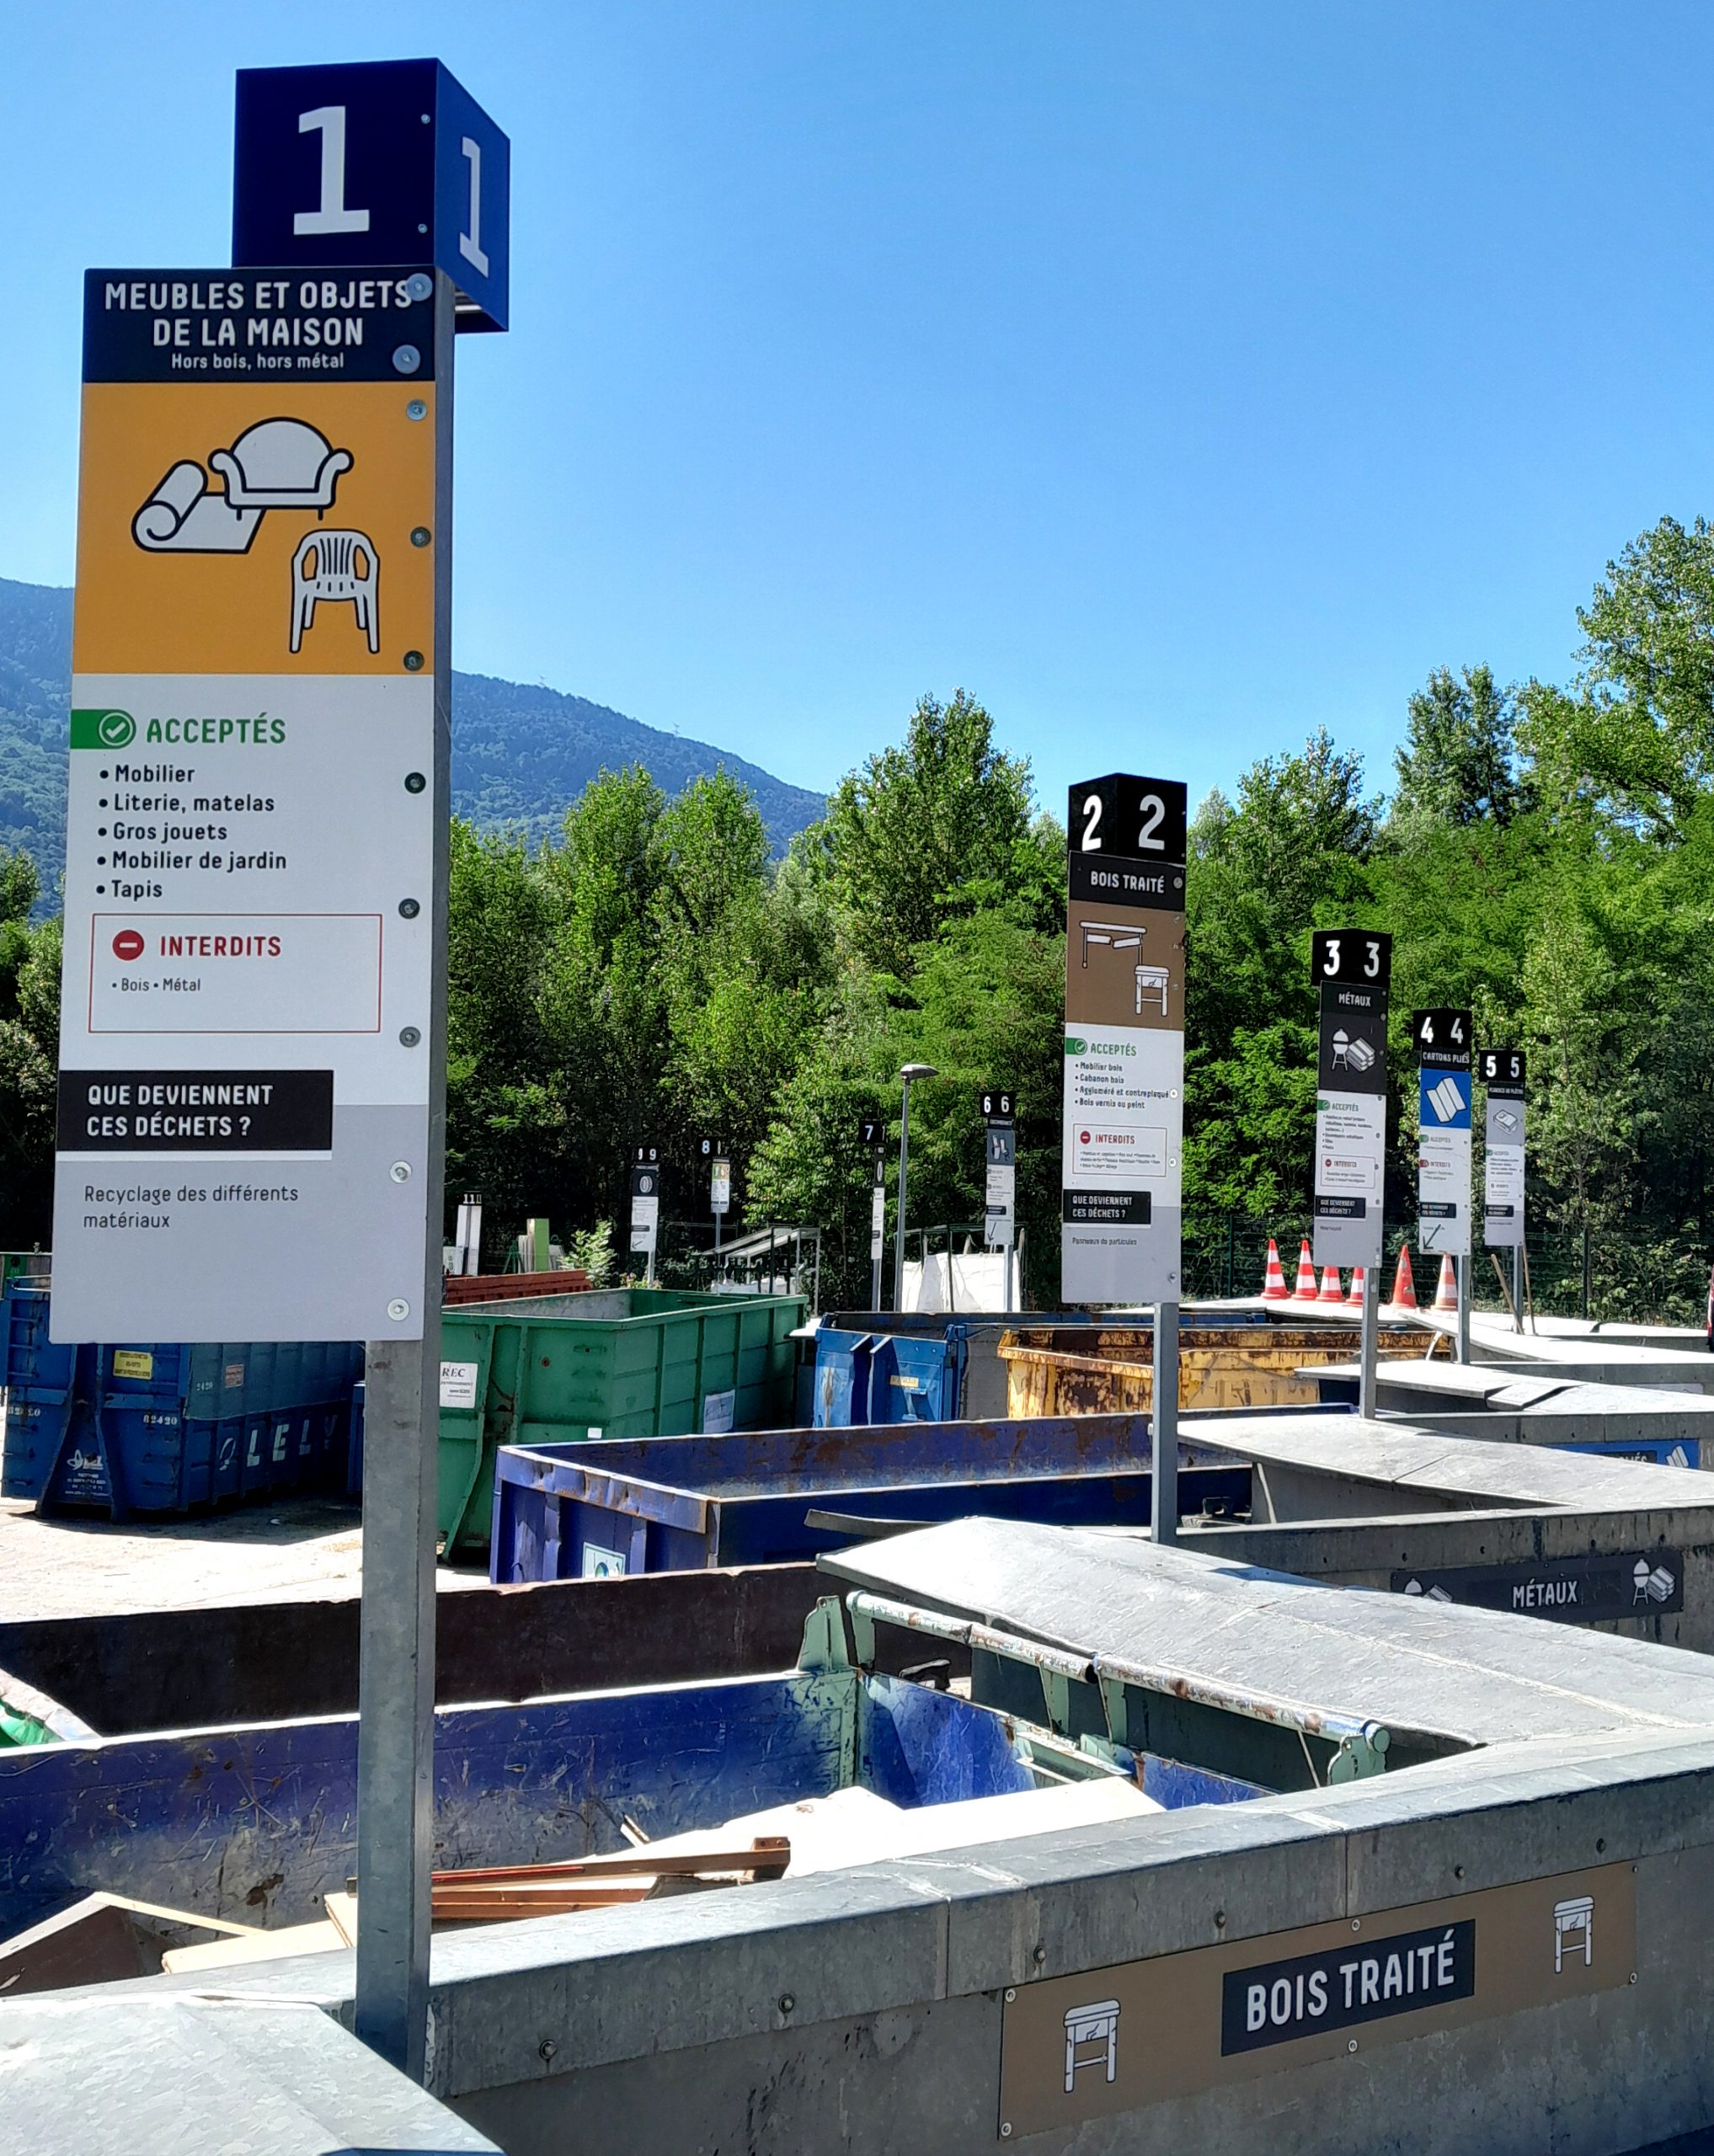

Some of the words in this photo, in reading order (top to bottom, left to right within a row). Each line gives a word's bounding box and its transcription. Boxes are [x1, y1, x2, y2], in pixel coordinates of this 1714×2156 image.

[293, 105, 370, 235] 1
[460, 136, 489, 279] 1
[104, 282, 244, 310] MEUBLES
[255, 281, 286, 309] ET
[300, 280, 413, 309] OBJETS
[153, 318, 190, 346] DE
[202, 318, 237, 346] LA
[248, 318, 364, 345] MAISON
[171, 353, 208, 369] Hors
[213, 353, 252, 371] bois,
[257, 352, 293, 369] hors
[296, 351, 344, 369] métal
[147, 712, 286, 744] ACCEPTÉS
[115, 764, 195, 783] Mobilier
[114, 794, 187, 814] Literie,
[194, 794, 275, 812] matelas
[1081, 794, 1103, 852] 2
[1138, 794, 1166, 851] 2
[113, 823, 157, 841] Gros
[161, 823, 227, 844] jouets
[112, 851, 192, 870] Mobilier
[199, 851, 222, 869] de
[227, 851, 286, 873] jardin
[111, 880, 163, 901] Tapis
[1090, 870, 1119, 889] BOIS
[1122, 874, 1165, 894] TRAITÉ
[160, 936, 281, 958] INTERDITS
[1323, 940, 1341, 976] 3
[1364, 942, 1380, 977] 3
[121, 978, 150, 992] Bois
[163, 978, 201, 992] Métal
[1338, 991, 1371, 1006] MÉTAUX
[1421, 1017, 1434, 1043] 4
[1450, 1017, 1464, 1044] 4
[1091, 1043, 1137, 1056] ACCEPTÉS
[1423, 1052, 1451, 1062] CARTONS
[1080, 1062, 1108, 1070] Mobilier
[1108, 1063, 1123, 1071] bois
[1486, 1055, 1497, 1077] 5
[1510, 1057, 1519, 1078] 5
[1080, 1074, 1108, 1083] Cabanon
[88, 1085, 131, 1107] QUE
[137, 1085, 274, 1106] DEVIENNENT
[1080, 1097, 1093, 1106] Bois
[1116, 1087, 1124, 1096] et
[984, 1096, 991, 1113] 6
[1001, 1096, 1009, 1113] 6
[87, 1116, 128, 1137] CES
[136, 1111, 232, 1137] DÉCHETS
[238, 1115, 252, 1136] ?
[865, 1125, 873, 1140] 7
[702, 1139, 710, 1154] 8
[1096, 1134, 1135, 1145] INTERDITS
[649, 1148, 657, 1161] 9
[84, 1185, 171, 1206] Recyclage
[176, 1185, 207, 1203] des
[212, 1184, 299, 1203] différents
[1072, 1195, 1088, 1204] QUE
[1089, 1196, 1133, 1206] DEVIENNENT
[83, 1210, 171, 1229] matériaux
[1072, 1208, 1087, 1217] CES
[1087, 1207, 1120, 1218] DÉCHETS
[1121, 1209, 1126, 1218] ?
[1513, 1578, 1578, 1609] MÉTAUX
[1247, 1970, 1328, 2033] BOIS
[1340, 1929, 1455, 2010] TRAITÉ
